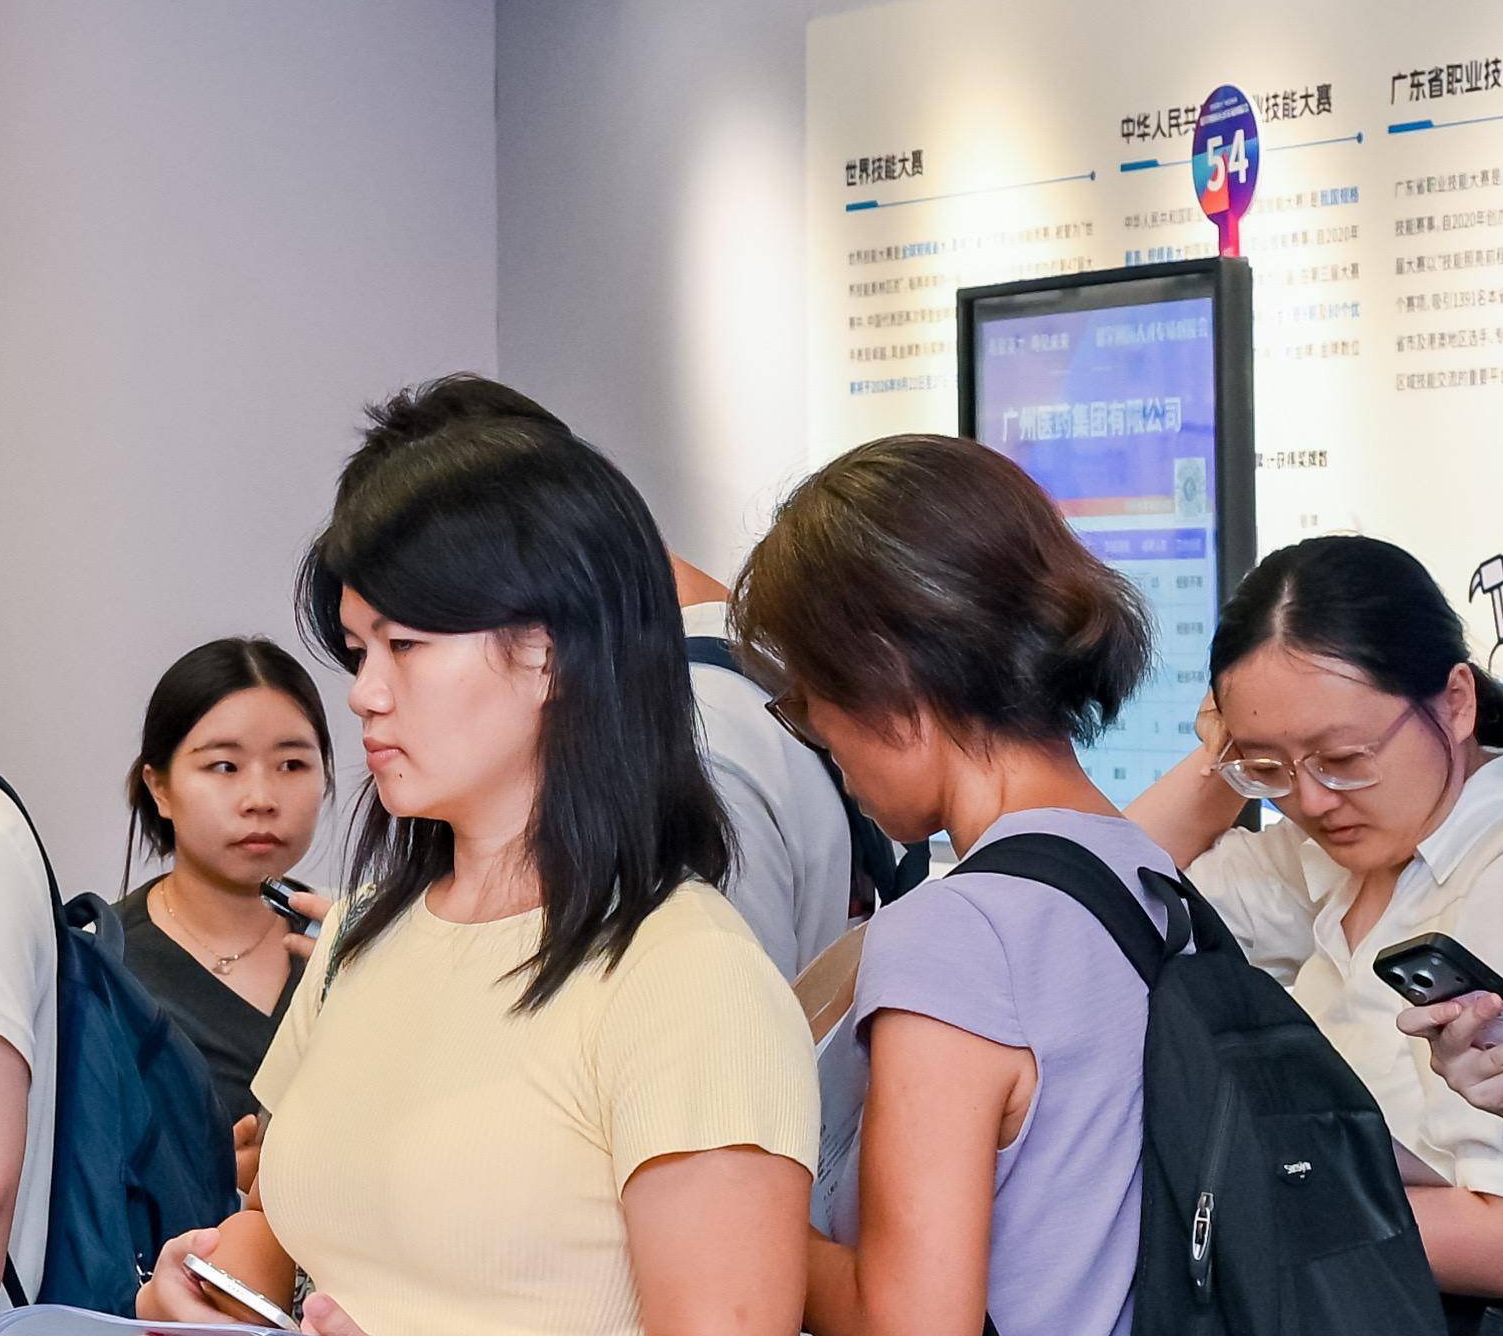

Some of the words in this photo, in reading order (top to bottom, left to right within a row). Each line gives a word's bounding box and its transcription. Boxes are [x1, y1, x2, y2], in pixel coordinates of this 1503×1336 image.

[845, 149, 925, 187] 世界技能大赛
[1206, 128, 1250, 193] 54
